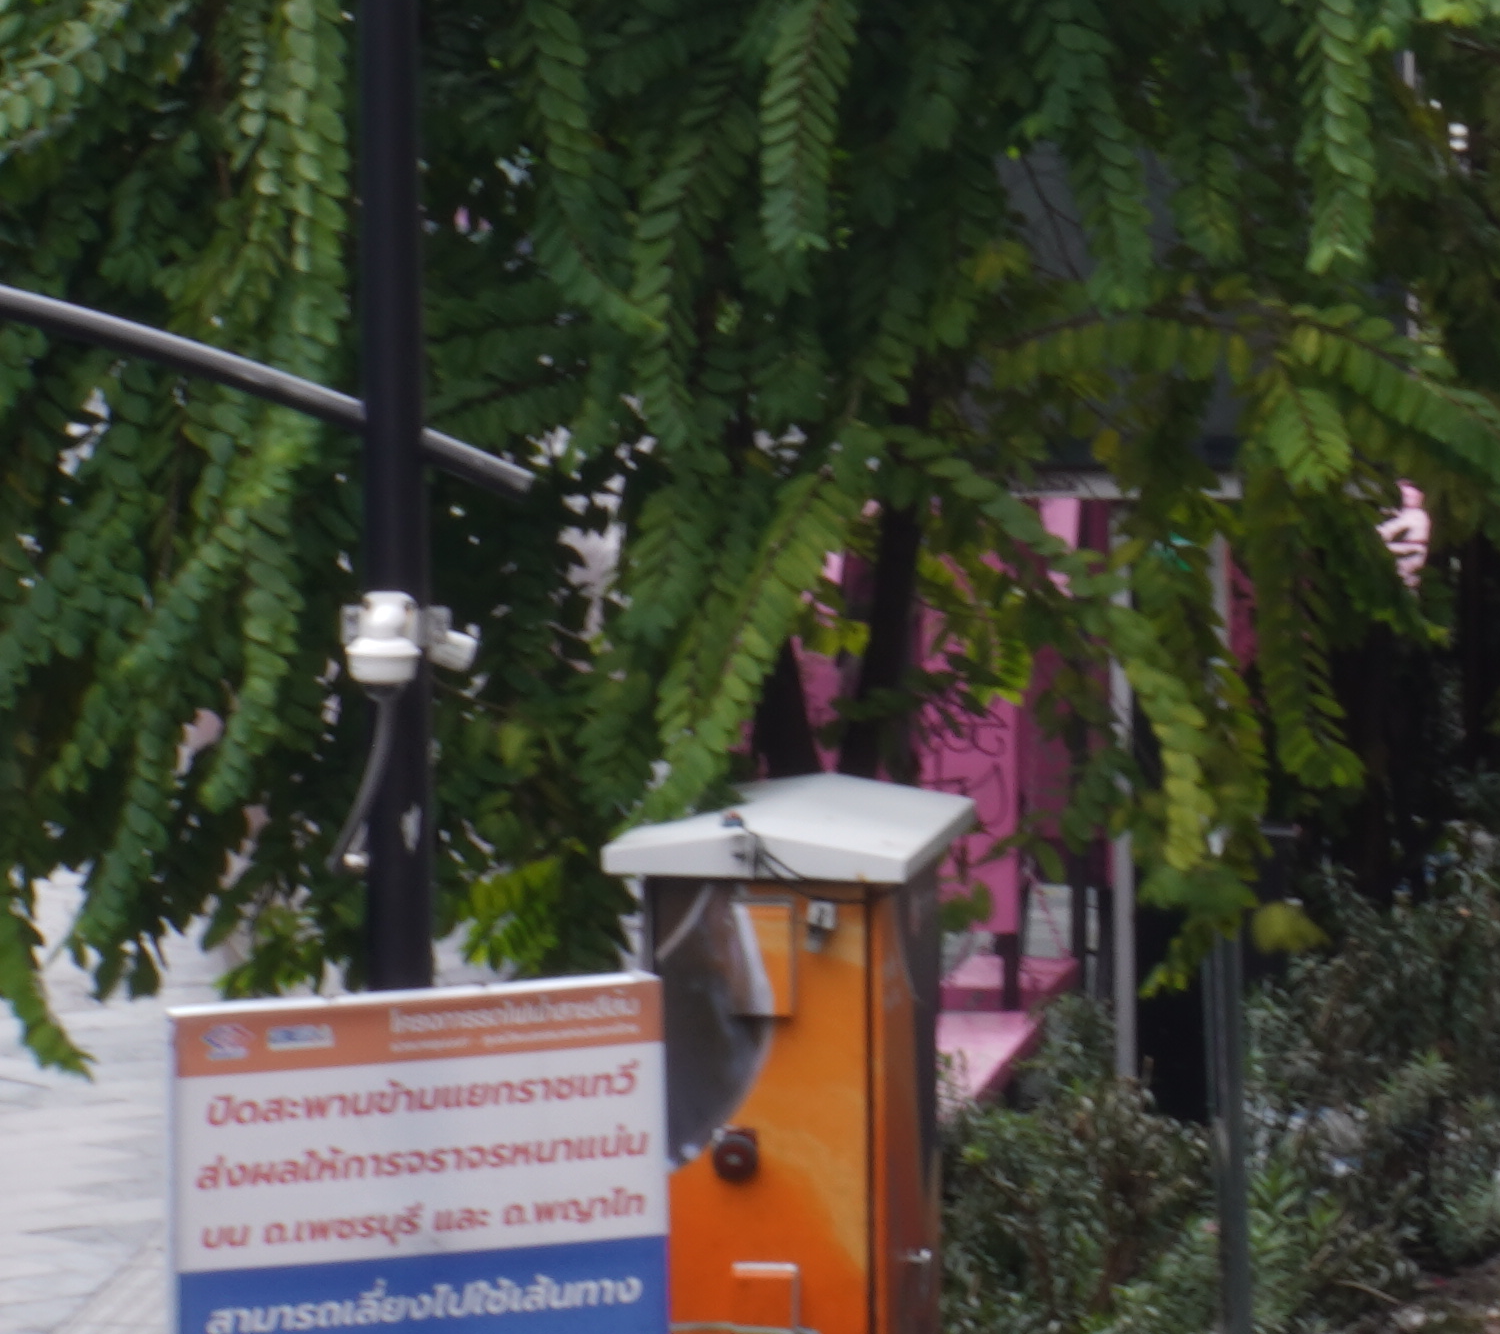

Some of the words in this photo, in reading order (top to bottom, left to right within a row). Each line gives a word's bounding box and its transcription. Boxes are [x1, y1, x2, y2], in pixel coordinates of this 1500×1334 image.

[208, 1061, 641, 1126] ปิดสะพานข้ามแยกราชเทวี
[196, 1125, 649, 1190] ส่งผลให้การจราจรหนาแน่น
[202, 1224, 249, 1249] บน
[263, 1202, 424, 1247] ถ.เพชรบุรี
[433, 1204, 489, 1231] และ
[503, 1187, 646, 1227] ถ.พญาไท
